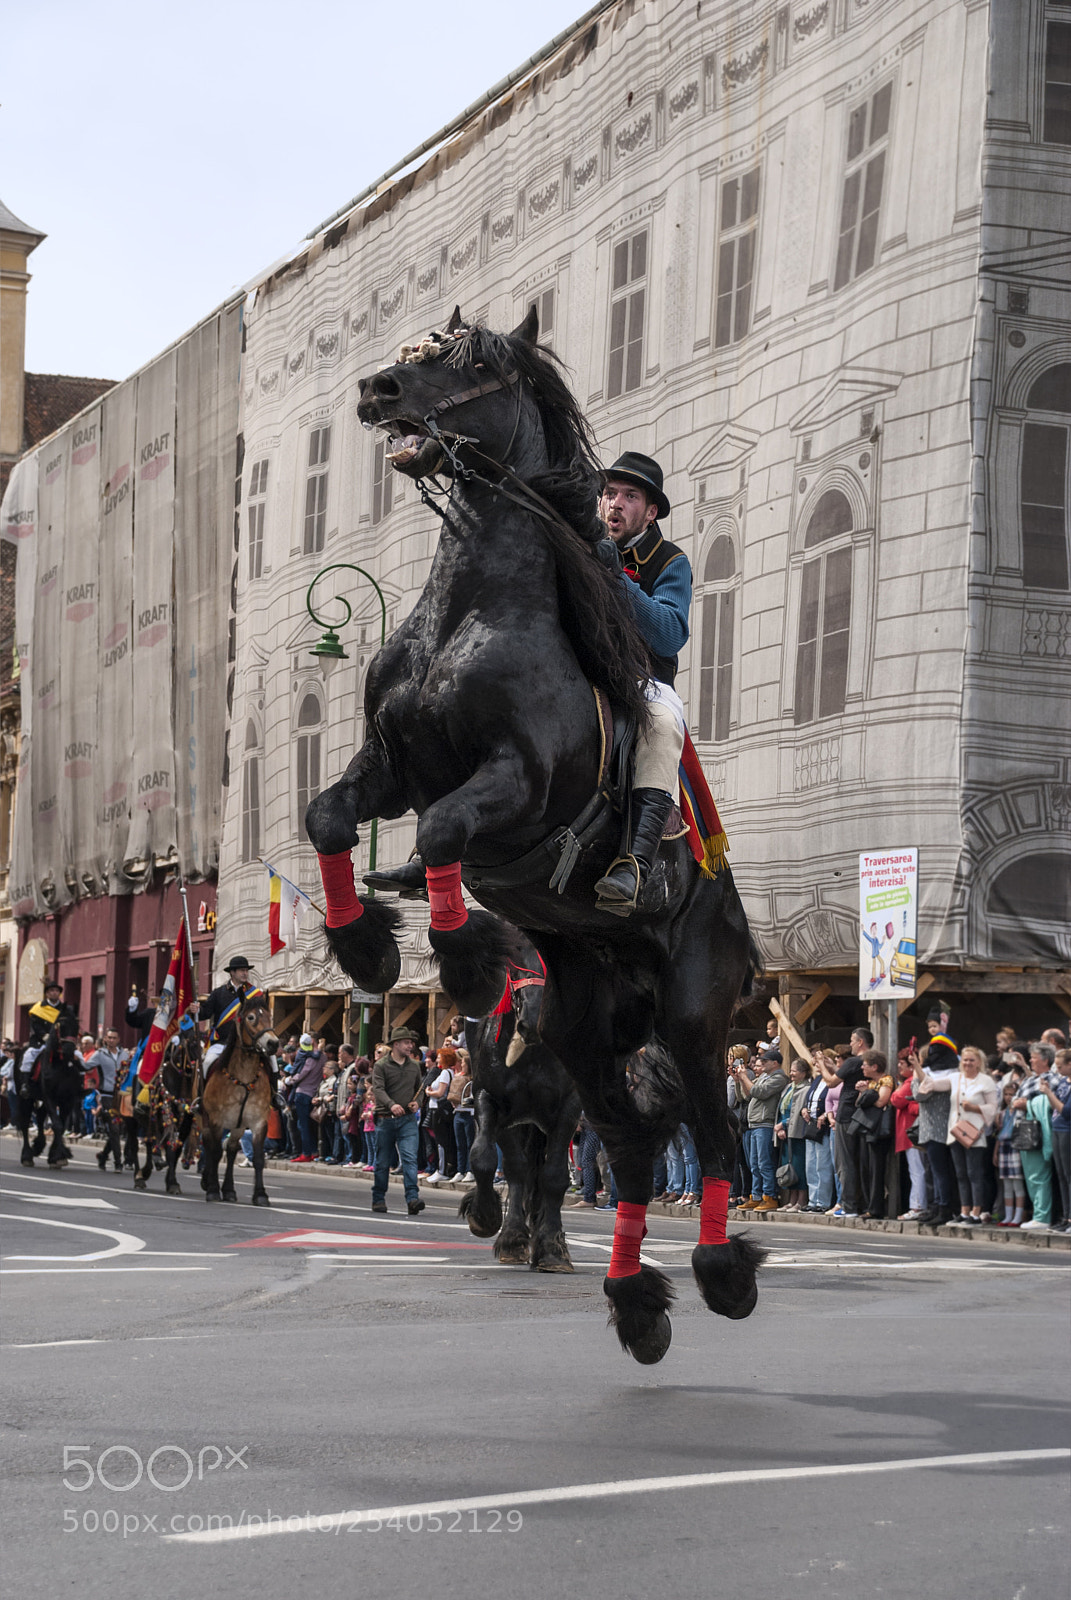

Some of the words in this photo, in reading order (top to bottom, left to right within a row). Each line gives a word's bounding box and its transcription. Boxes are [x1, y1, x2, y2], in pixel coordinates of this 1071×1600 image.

[72, 424, 97, 450] KRAFT
[140, 432, 170, 465] KRAFT
[46, 453, 63, 475] KRAFT
[104, 476, 130, 516] KRAFT
[41, 564, 58, 586] KRAFT
[66, 583, 95, 605] KRAFT
[138, 604, 168, 631] KRAFT
[38, 680, 55, 698] KRAFT
[64, 741, 93, 762] KRAFT
[137, 770, 170, 794] KRAFT
[864, 855, 912, 867] Traversarea
[861, 869, 873, 880] prin
[875, 868, 890, 876] acest
[892, 866, 901, 874] loc
[903, 865, 916, 873] este
